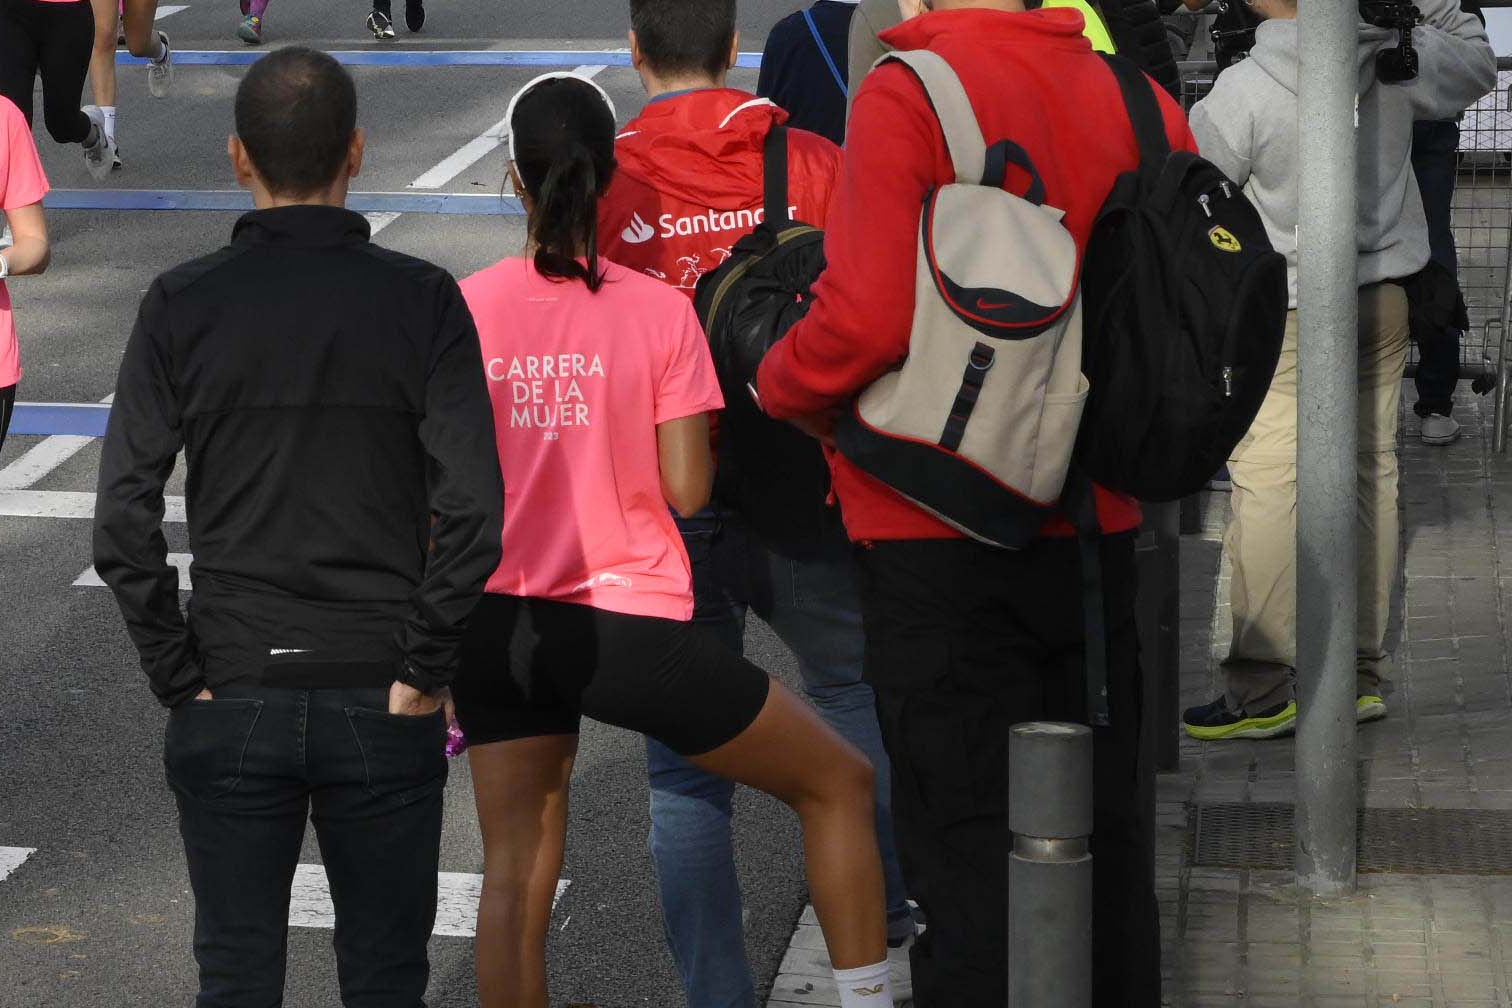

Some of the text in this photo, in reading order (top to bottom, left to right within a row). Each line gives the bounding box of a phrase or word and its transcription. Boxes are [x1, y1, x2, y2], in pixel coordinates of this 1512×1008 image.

[487, 353, 606, 382] CARRERA
[512, 380, 584, 404] DE LA
[510, 403, 590, 429] MUJER
